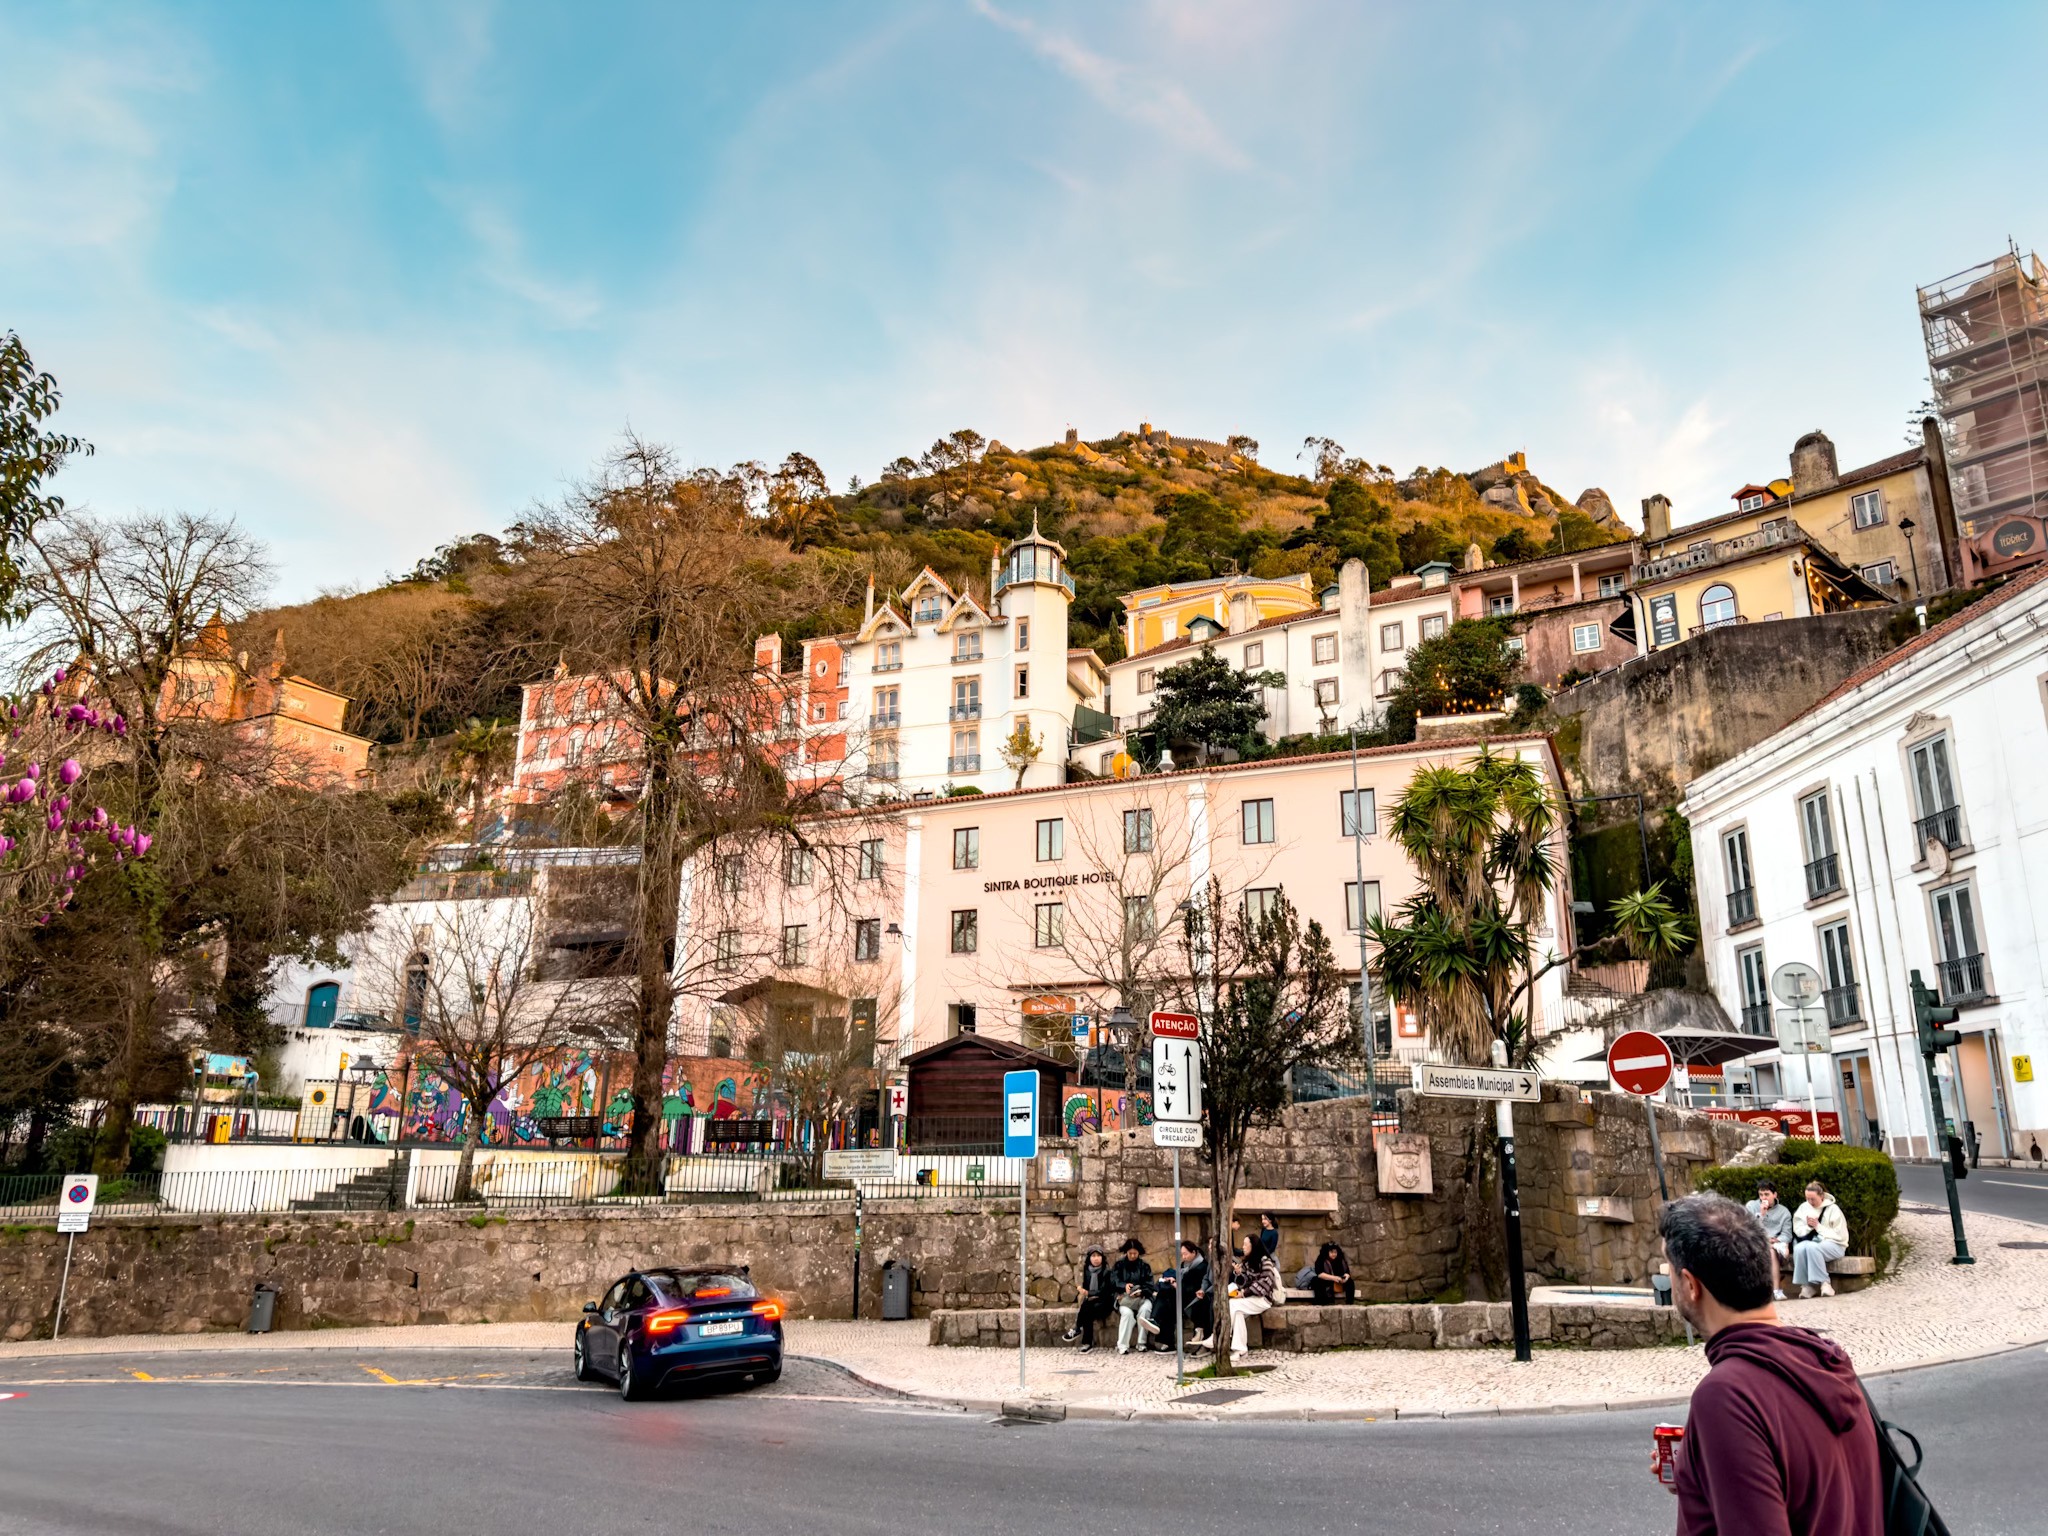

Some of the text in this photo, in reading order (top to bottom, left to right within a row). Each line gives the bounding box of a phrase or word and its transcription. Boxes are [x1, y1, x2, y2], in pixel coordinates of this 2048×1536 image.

[1999, 532, 2028, 548] TERRACE
[984, 872, 1116, 892] SINTRA BOUTIQUE HOTEL
[1154, 1019, 1195, 1033] ATENÇÃO
[1429, 1073, 1515, 1095] Assembleia Municipal
[1159, 1126, 1183, 1134] CIRCULE
[1161, 1134, 1195, 1143] PRECAUÇÃO
